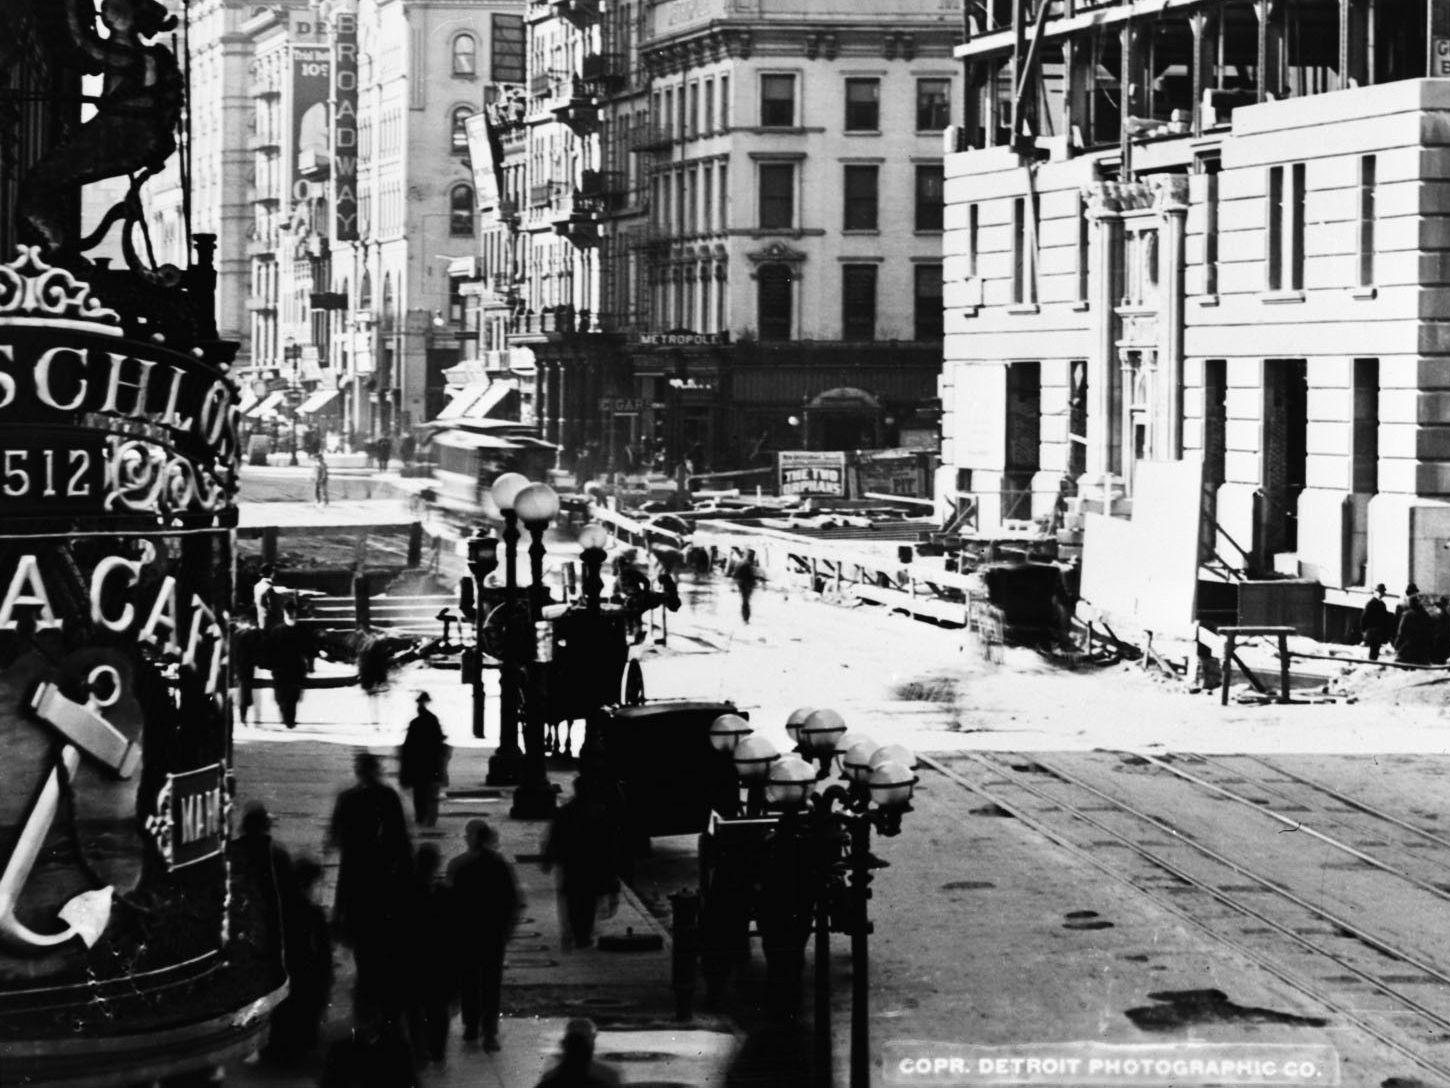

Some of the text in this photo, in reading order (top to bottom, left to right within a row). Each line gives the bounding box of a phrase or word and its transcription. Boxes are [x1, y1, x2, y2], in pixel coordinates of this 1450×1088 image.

[336, 14, 356, 228] BROADWAY
[641, 334, 720, 345] METROPOLE
[3, 450, 90, 497] 512
[785, 468, 839, 482] THE TWO
